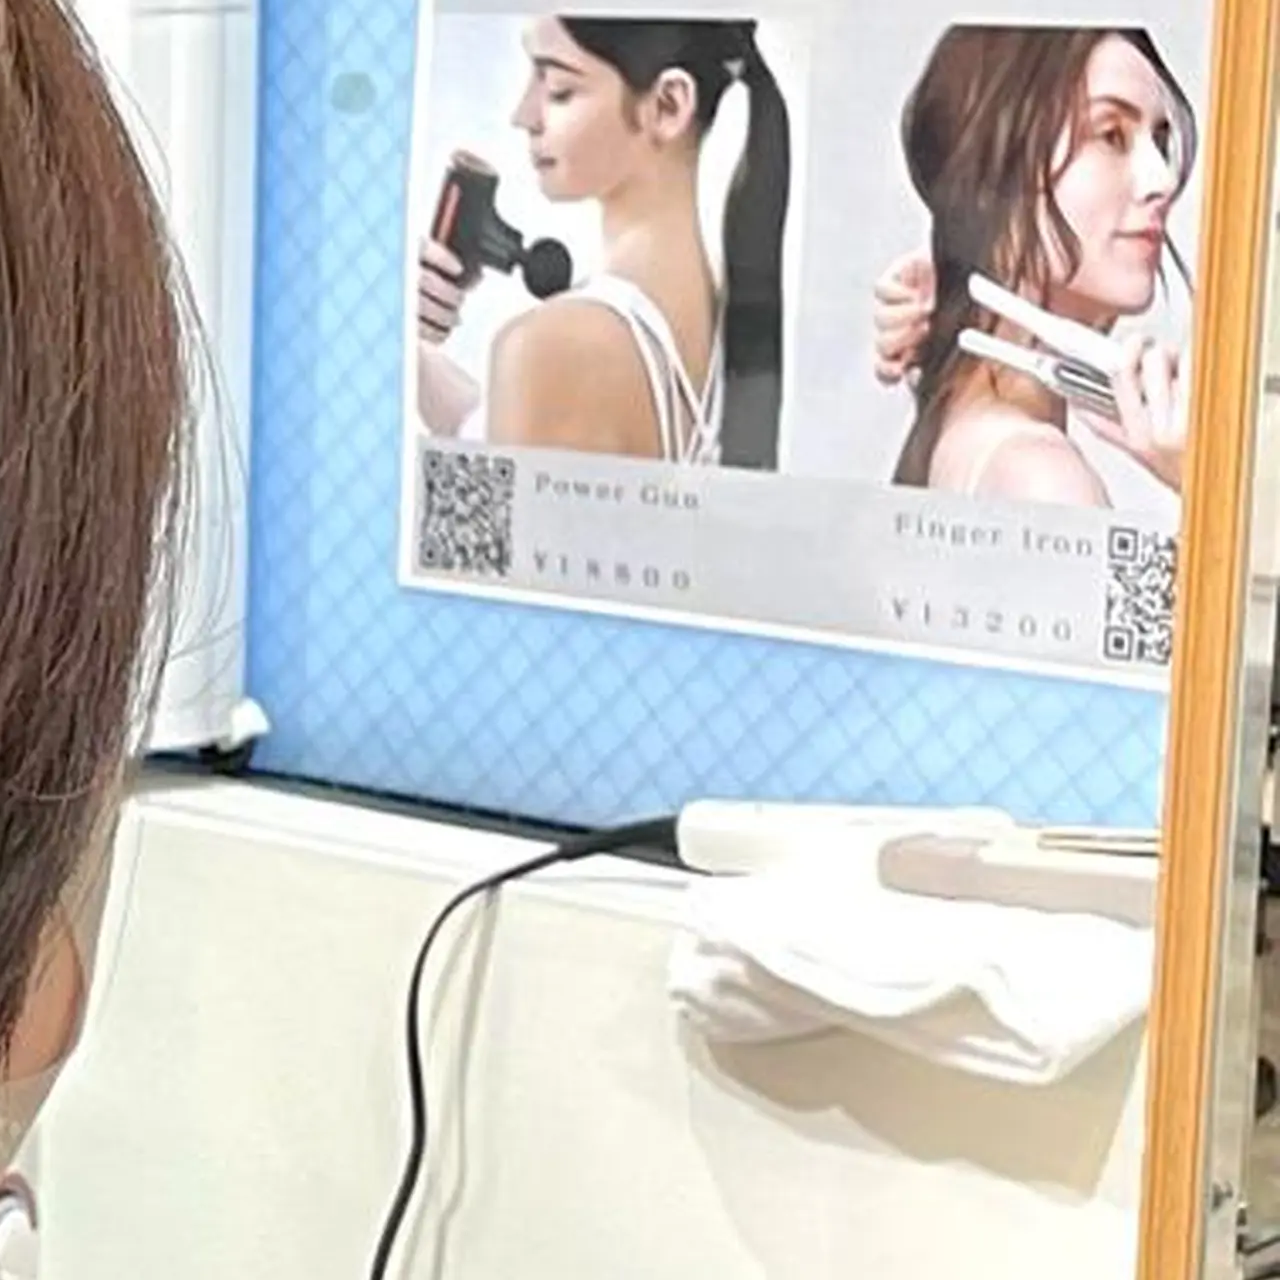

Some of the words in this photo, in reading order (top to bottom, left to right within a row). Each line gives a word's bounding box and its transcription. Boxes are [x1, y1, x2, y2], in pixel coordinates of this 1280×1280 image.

[534, 470, 625, 504] Power
[640, 483, 700, 510] Gun
[894, 512, 1002, 549] Finger
[1023, 526, 1093, 558] Iron
